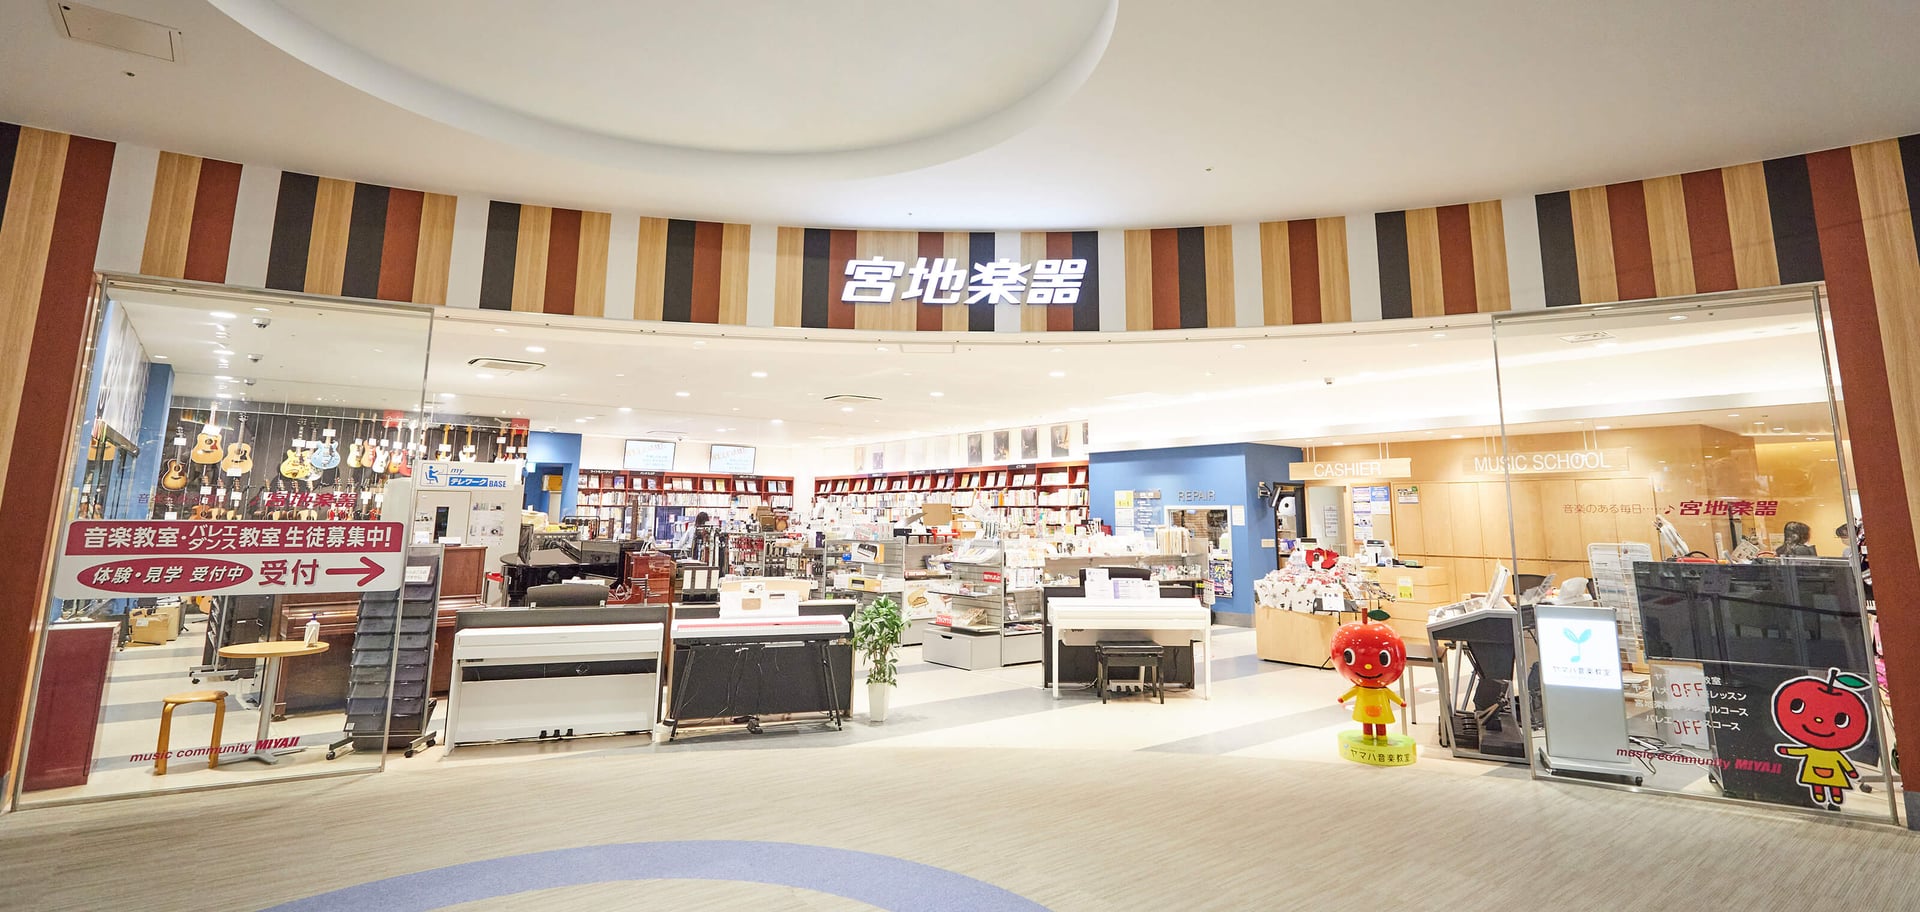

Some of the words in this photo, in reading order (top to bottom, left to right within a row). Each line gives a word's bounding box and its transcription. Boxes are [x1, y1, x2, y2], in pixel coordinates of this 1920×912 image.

[841, 256, 1088, 305] 宮地楽器
[1313, 461, 1382, 477] CASHIER
[1474, 455, 1528, 472] MUSIC
[1533, 452, 1610, 470] SCHOOL
[450, 478, 488, 486] テレワーク
[489, 480, 507, 488] BASE
[265, 492, 358, 508] 宮地楽器
[1178, 490, 1216, 502] REPAIR
[1679, 500, 1779, 516] 宮地楽器
[189, 524, 238, 537] バレエ
[188, 537, 237, 551] ダンス
[92, 565, 183, 584] 体験・見学
[189, 565, 244, 583] 受付中
[258, 558, 320, 587] 受付
[1670, 682, 1703, 698] OFF
[129, 749, 172, 763] music
[176, 743, 252, 759] community
[255, 736, 301, 750] MIYAJI
[1350, 749, 1410, 763] ヤマハ音楽教室
[1616, 748, 1655, 759] music
[1657, 752, 1731, 770] community
[1734, 758, 1782, 775] MIYAJI
